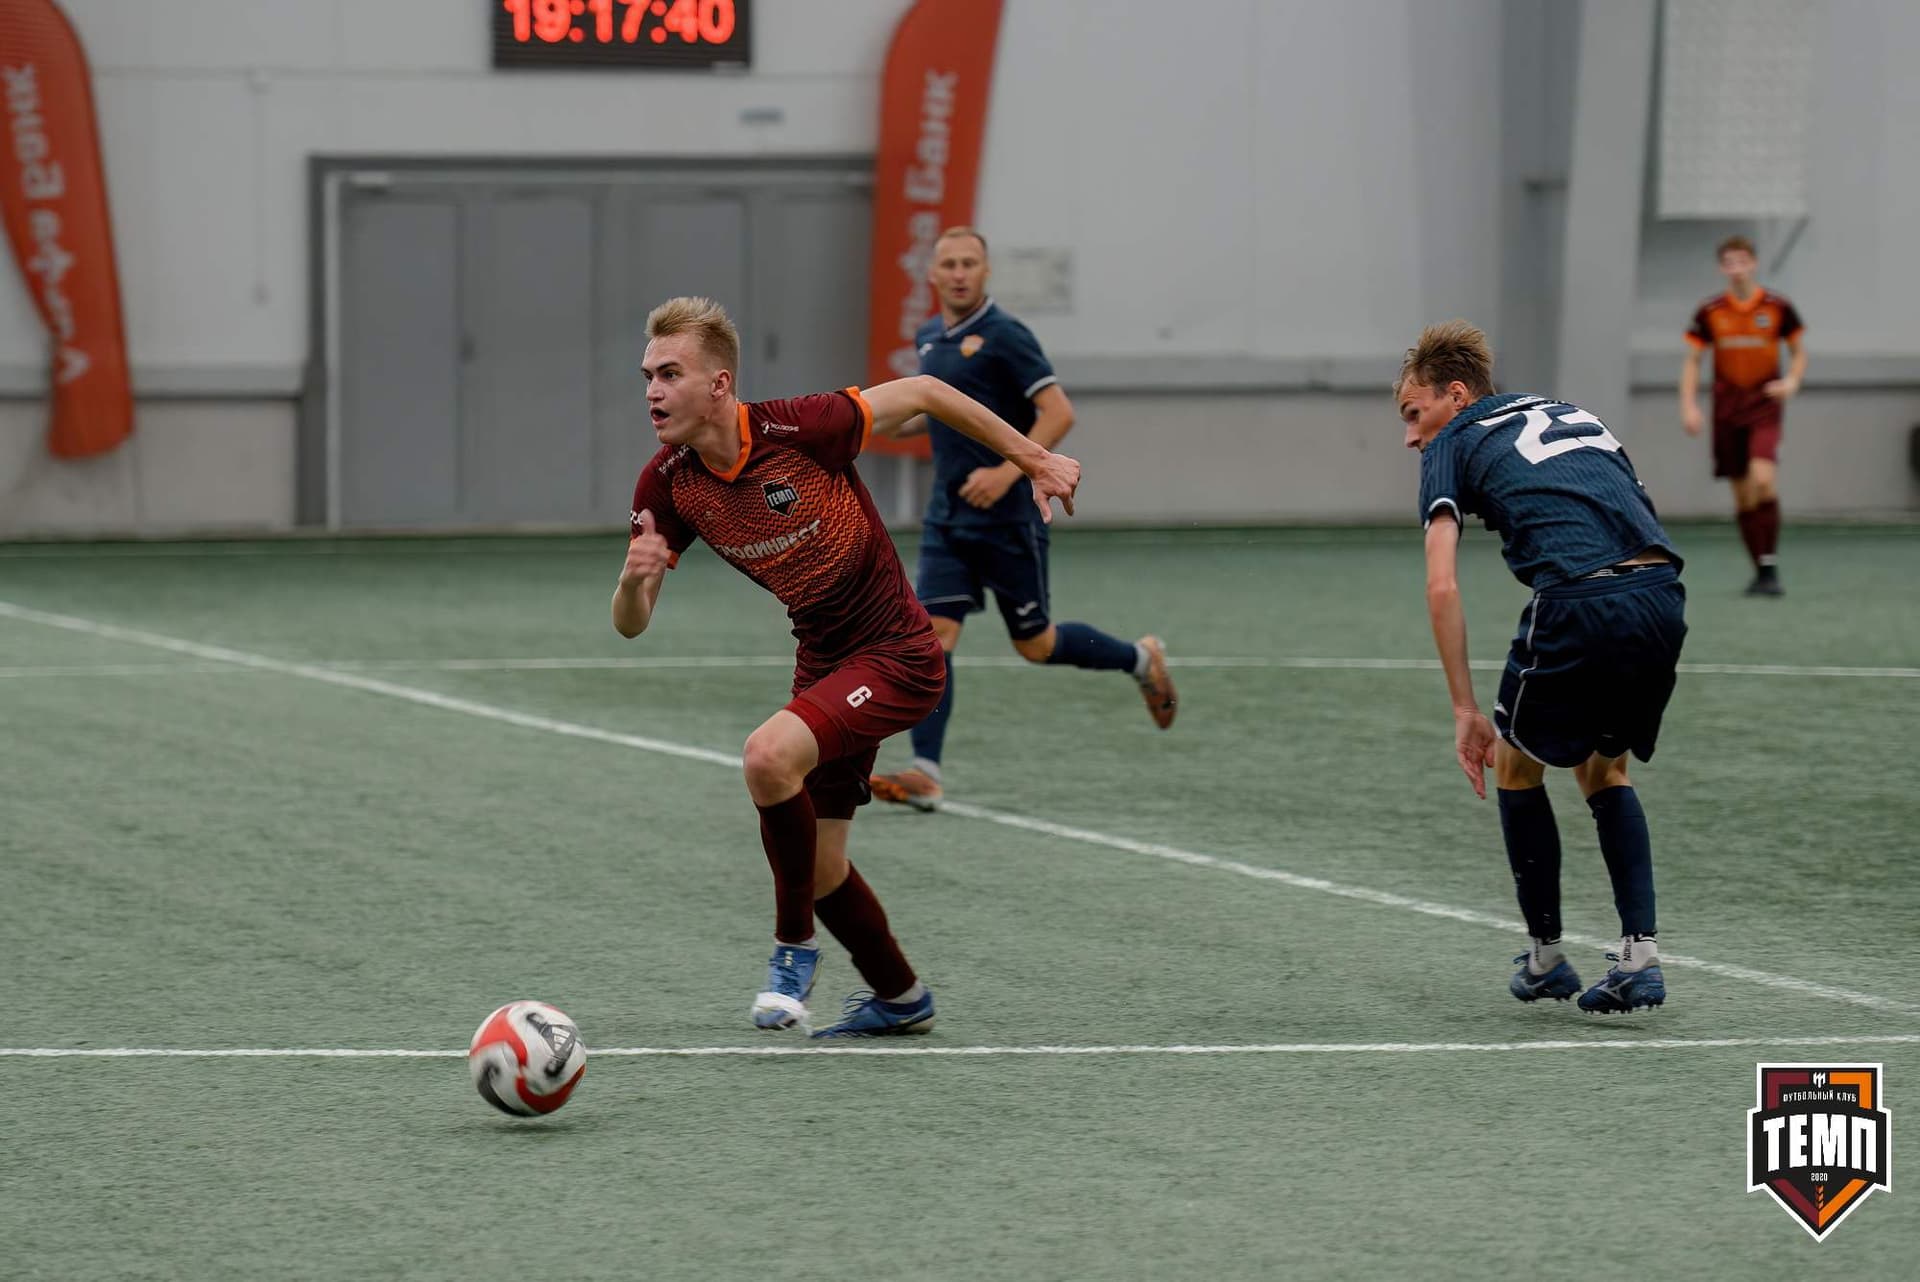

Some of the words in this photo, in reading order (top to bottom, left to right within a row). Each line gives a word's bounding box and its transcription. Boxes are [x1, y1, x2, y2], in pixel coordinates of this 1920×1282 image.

[504, 0, 736, 44] 19:17:40
[905, 68, 959, 204] Банк
[767, 488, 796, 508] ТЕМП
[846, 685, 873, 709] 6
